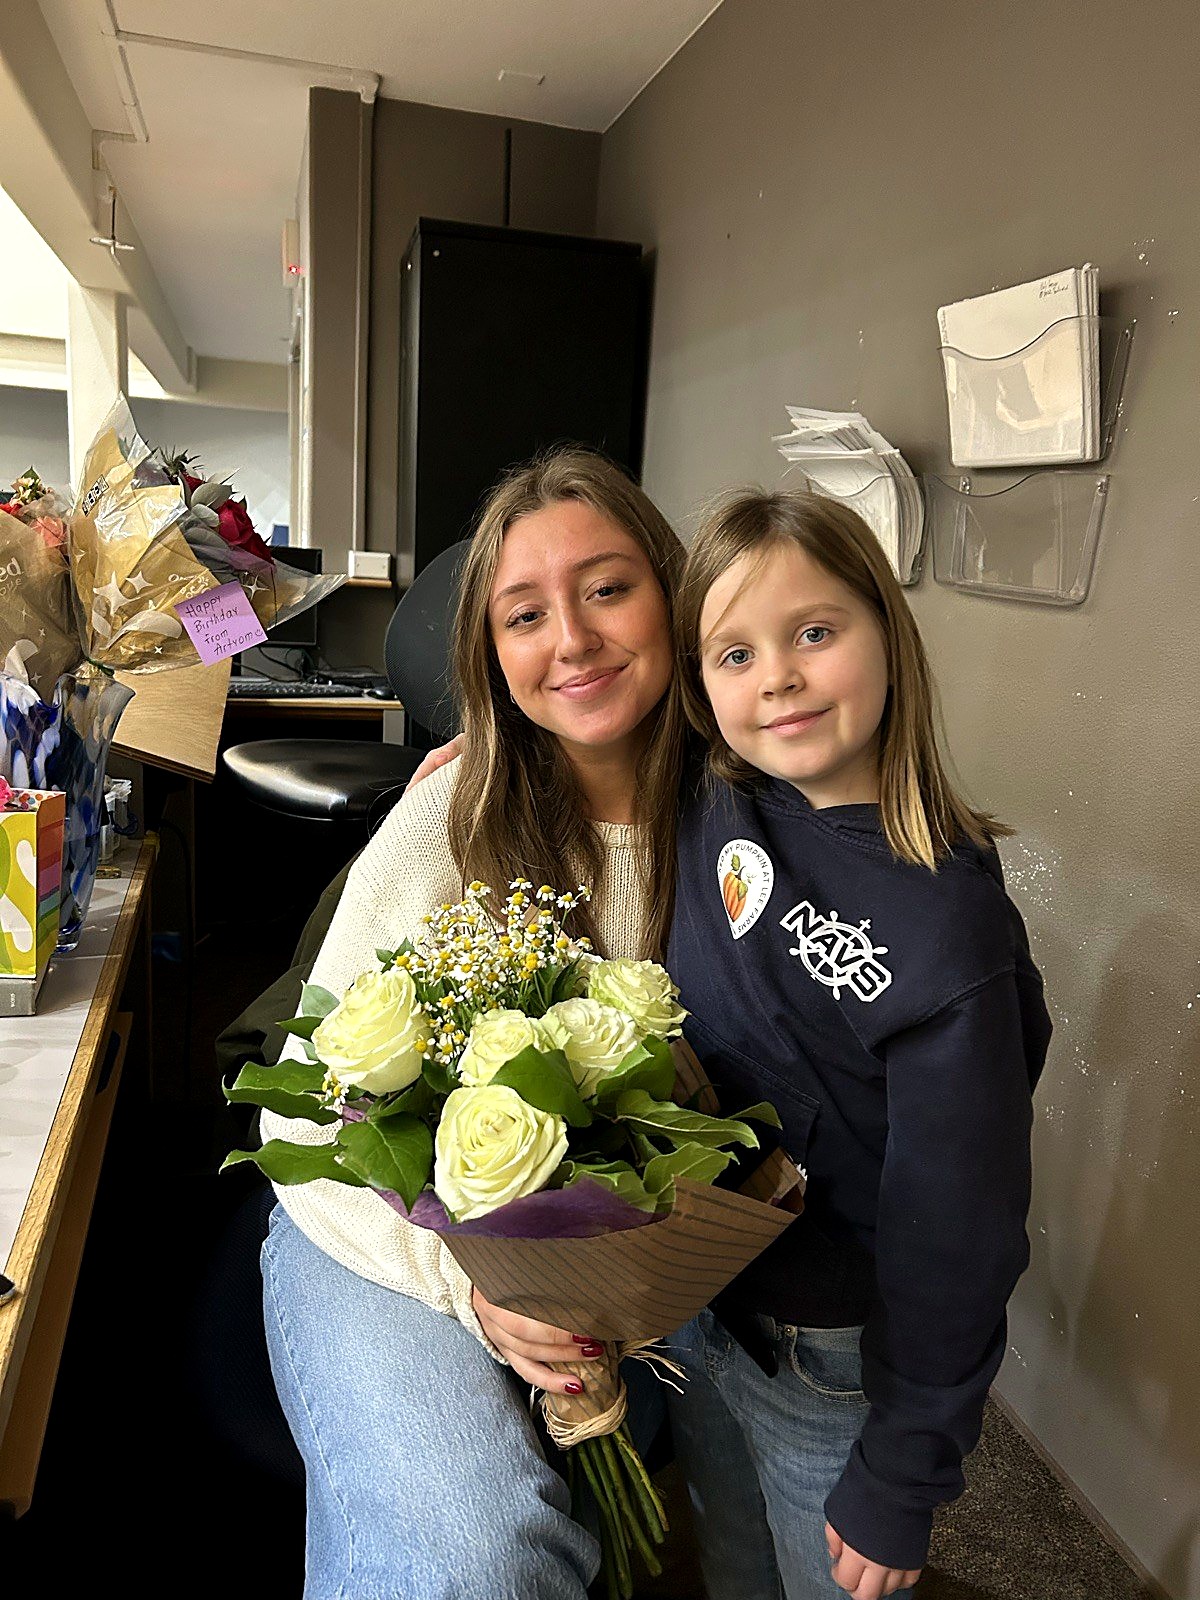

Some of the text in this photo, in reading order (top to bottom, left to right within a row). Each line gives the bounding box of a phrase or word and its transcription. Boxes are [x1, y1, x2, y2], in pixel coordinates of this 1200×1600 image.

[185, 595, 221, 618] Happy
[193, 606, 238, 633] Birthday
[735, 843, 768, 869] PUMPKIN
[762, 871, 770, 883] AT
[757, 887, 769, 906] LEE
[738, 907, 759, 933] FARMS
[781, 901, 891, 1001] NAVS
